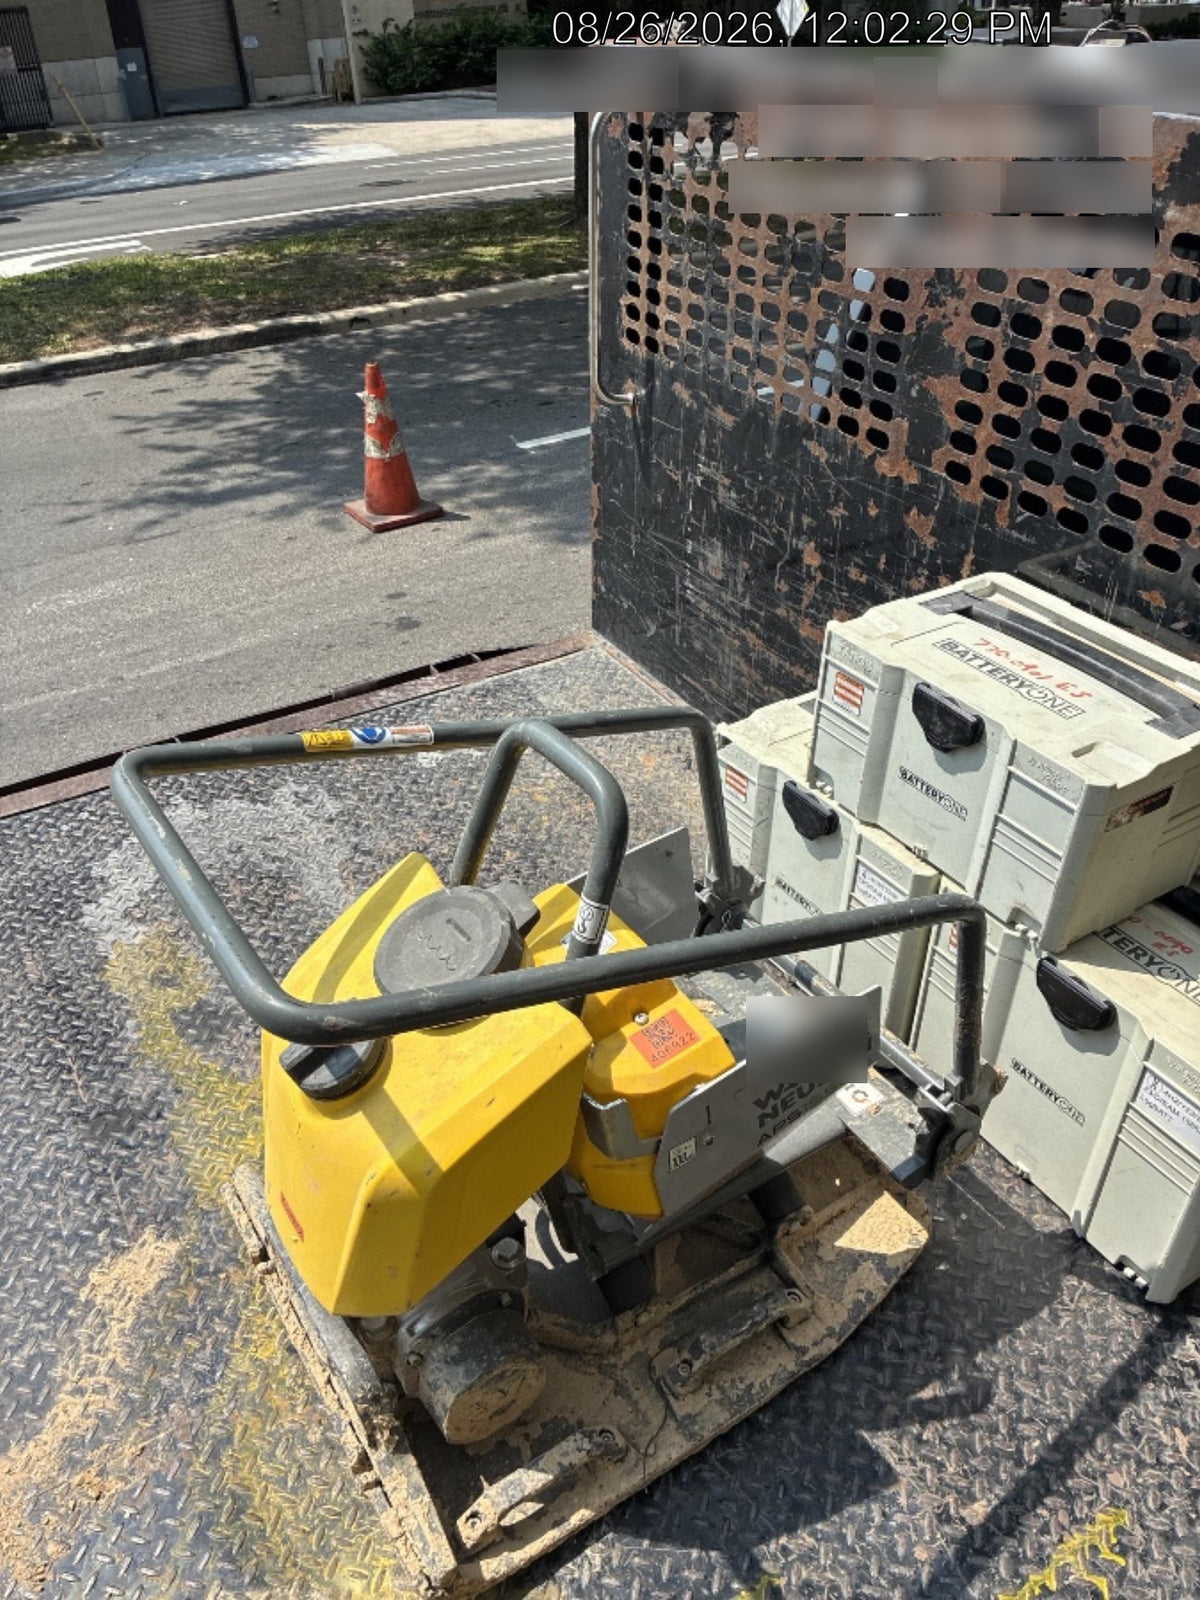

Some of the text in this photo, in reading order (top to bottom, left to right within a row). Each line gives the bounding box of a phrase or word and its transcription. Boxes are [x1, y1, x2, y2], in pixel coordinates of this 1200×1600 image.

[936, 639, 1083, 719] BATTERYONE
[900, 767, 967, 820] BATTERYONE
[1012, 1059, 1084, 1124] BATTERYONE
